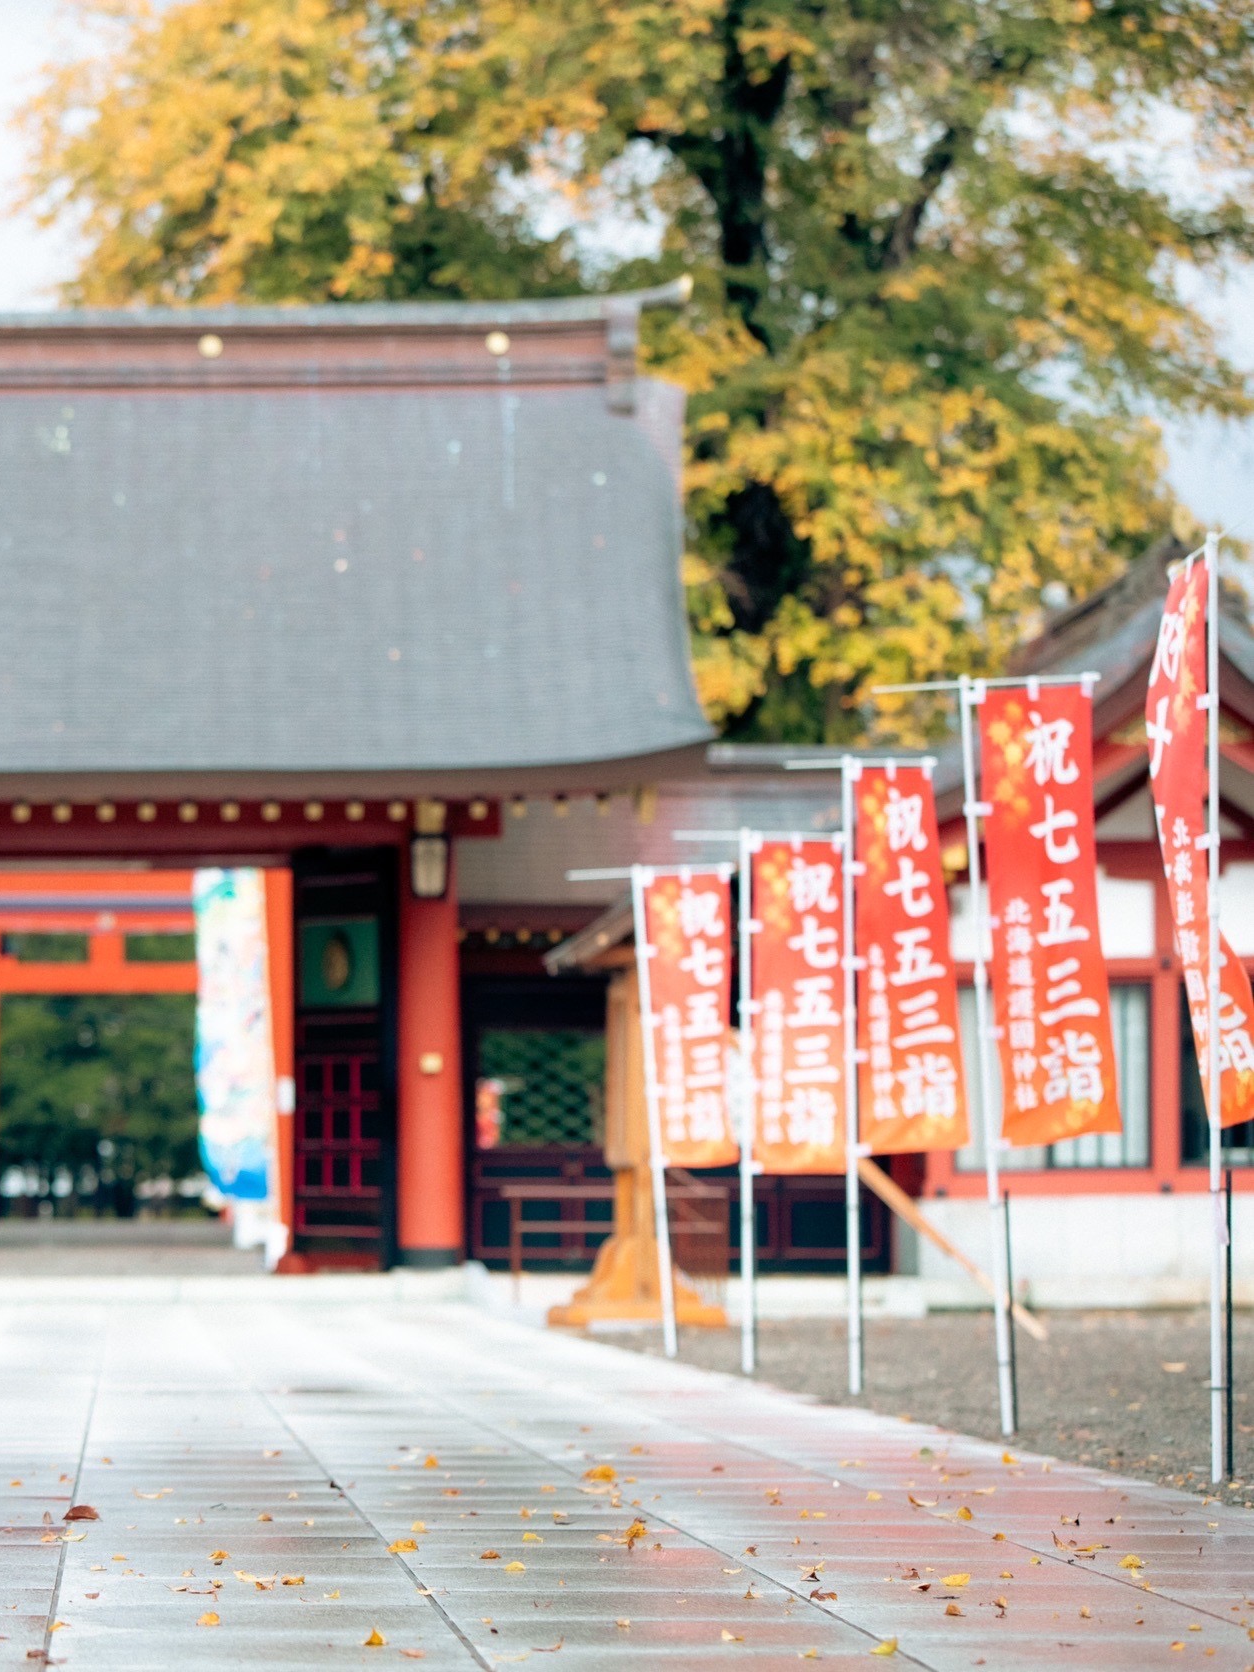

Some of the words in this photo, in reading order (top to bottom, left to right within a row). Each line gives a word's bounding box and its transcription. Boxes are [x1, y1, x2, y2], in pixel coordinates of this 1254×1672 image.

[884, 788, 956, 1119] 祝七五三詣
[1024, 713, 1103, 1105] 祝七五三詣
